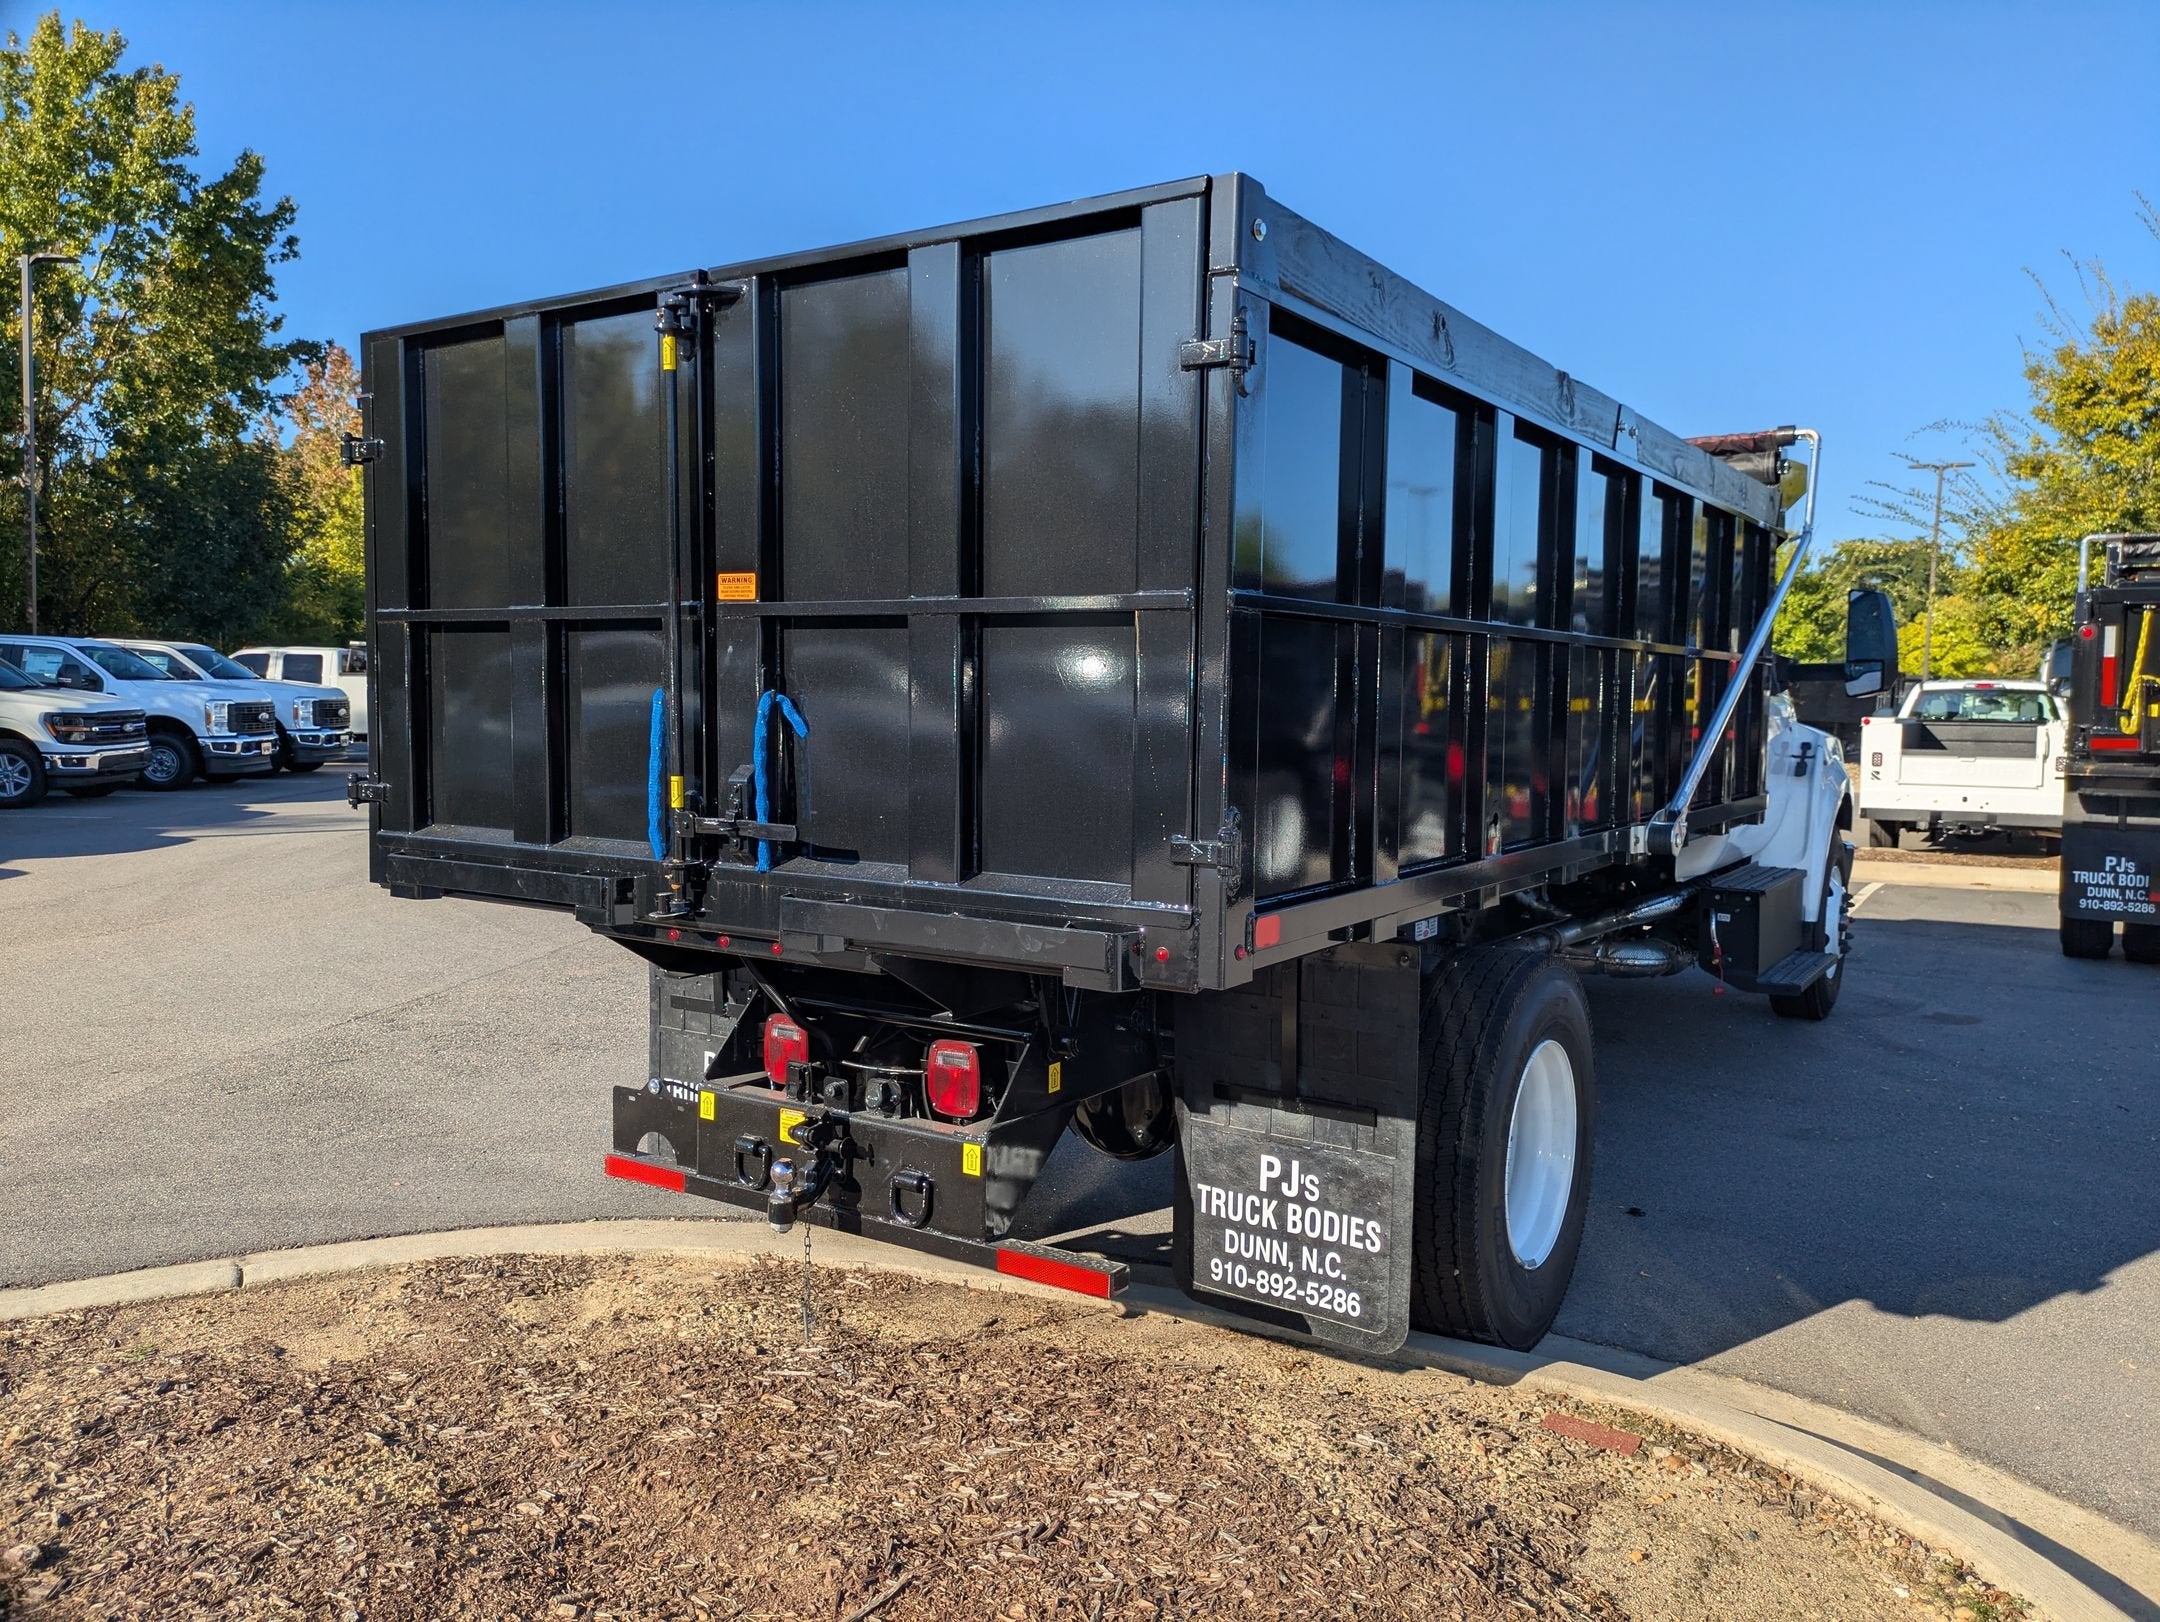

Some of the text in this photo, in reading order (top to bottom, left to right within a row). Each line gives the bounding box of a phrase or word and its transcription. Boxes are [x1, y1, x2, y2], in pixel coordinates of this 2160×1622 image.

[2072, 871, 2150, 888] TRUCK BODI
[2087, 886, 2149, 901] DUNN, N.C.
[2079, 898, 2156, 913] 910-892-5286
[1197, 1183, 1382, 1253] TRUCK BODIES
[1224, 1228, 1348, 1281] DUNN, N.C.
[1210, 1257, 1361, 1318] 910-892-5286
